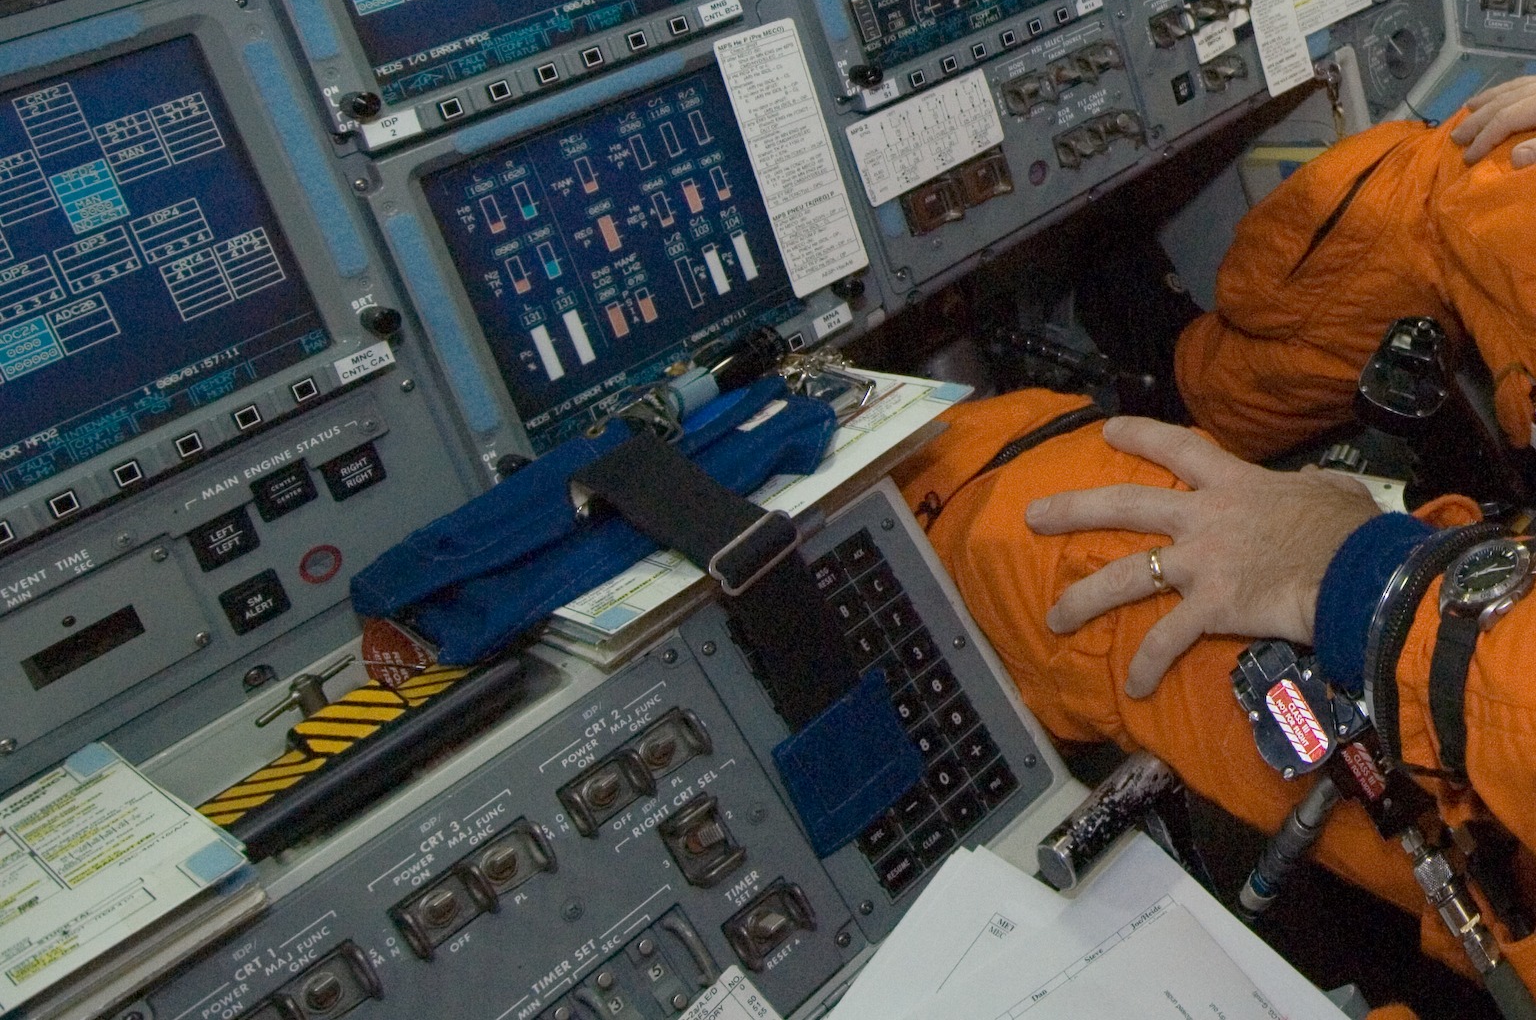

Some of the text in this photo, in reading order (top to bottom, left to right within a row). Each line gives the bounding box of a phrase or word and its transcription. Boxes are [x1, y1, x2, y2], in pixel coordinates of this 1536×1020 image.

[704, 4, 739, 22] CNTL BC2
[710, 0, 727, 10] MNB
[376, 32, 490, 77] MEDS I/O ERROR MFD2
[25, 87, 60, 105] CRT2
[381, 117, 398, 129] IDP
[390, 129, 397, 137] 2
[118, 146, 145, 161] MAN
[148, 208, 180, 225] IDP4
[55, 300, 96, 322] ADC2B
[352, 294, 374, 310] BRT
[342, 354, 390, 379] CNTL CA1
[351, 350, 374, 365] MNC
[202, 426, 341, 501] MAIN ENGINE STATUS
[341, 457, 368, 477] RIGHT
[270, 476, 296, 491] CENTER
[346, 469, 373, 488] RIGHT
[277, 488, 303, 504] CENTER
[209, 524, 235, 542] LEFT
[216, 537, 240, 555] LEFT
[0, 549, 90, 599] EVENT TIME
[74, 559, 94, 574] SEC
[874, 580, 883, 592] C
[7, 591, 32, 608] MIN
[247, 594, 262, 606] SM
[244, 599, 274, 619] ALERT
[913, 647, 922, 660] 3
[932, 679, 942, 692] 6
[610, 694, 662, 734] MAJ FUNC
[629, 713, 652, 732] GNC
[952, 712, 961, 725] 9
[1276, 699, 1309, 746] NOT FOR FLIGHT
[1288, 702, 1310, 733] CLASS III
[584, 710, 620, 739] CRT 2
[561, 740, 599, 768] POWER
[578, 753, 596, 768] ON
[671, 777, 683, 788] PL
[632, 770, 718, 839] RIGHT CRT SEL
[448, 804, 506, 849] MAJ FUNC
[612, 812, 632, 831] OFF
[420, 821, 460, 853] CRT 3
[469, 824, 495, 846] GNC
[922, 831, 942, 850] CLEAR
[393, 853, 435, 886] POWER
[411, 869, 432, 886] ON
[886, 858, 910, 882] RESUME
[724, 870, 760, 902] TIMER
[735, 891, 751, 906] SET
[449, 933, 472, 953] OFF
[602, 934, 622, 953] SEC
[766, 944, 793, 970] RESET
[1084, 949, 1104, 964] Steve
[531, 939, 596, 994] TIMER SET
[651, 965, 663, 977] 5
[1031, 988, 1048, 1002] Dan
[612, 1000, 621, 1011] 3
